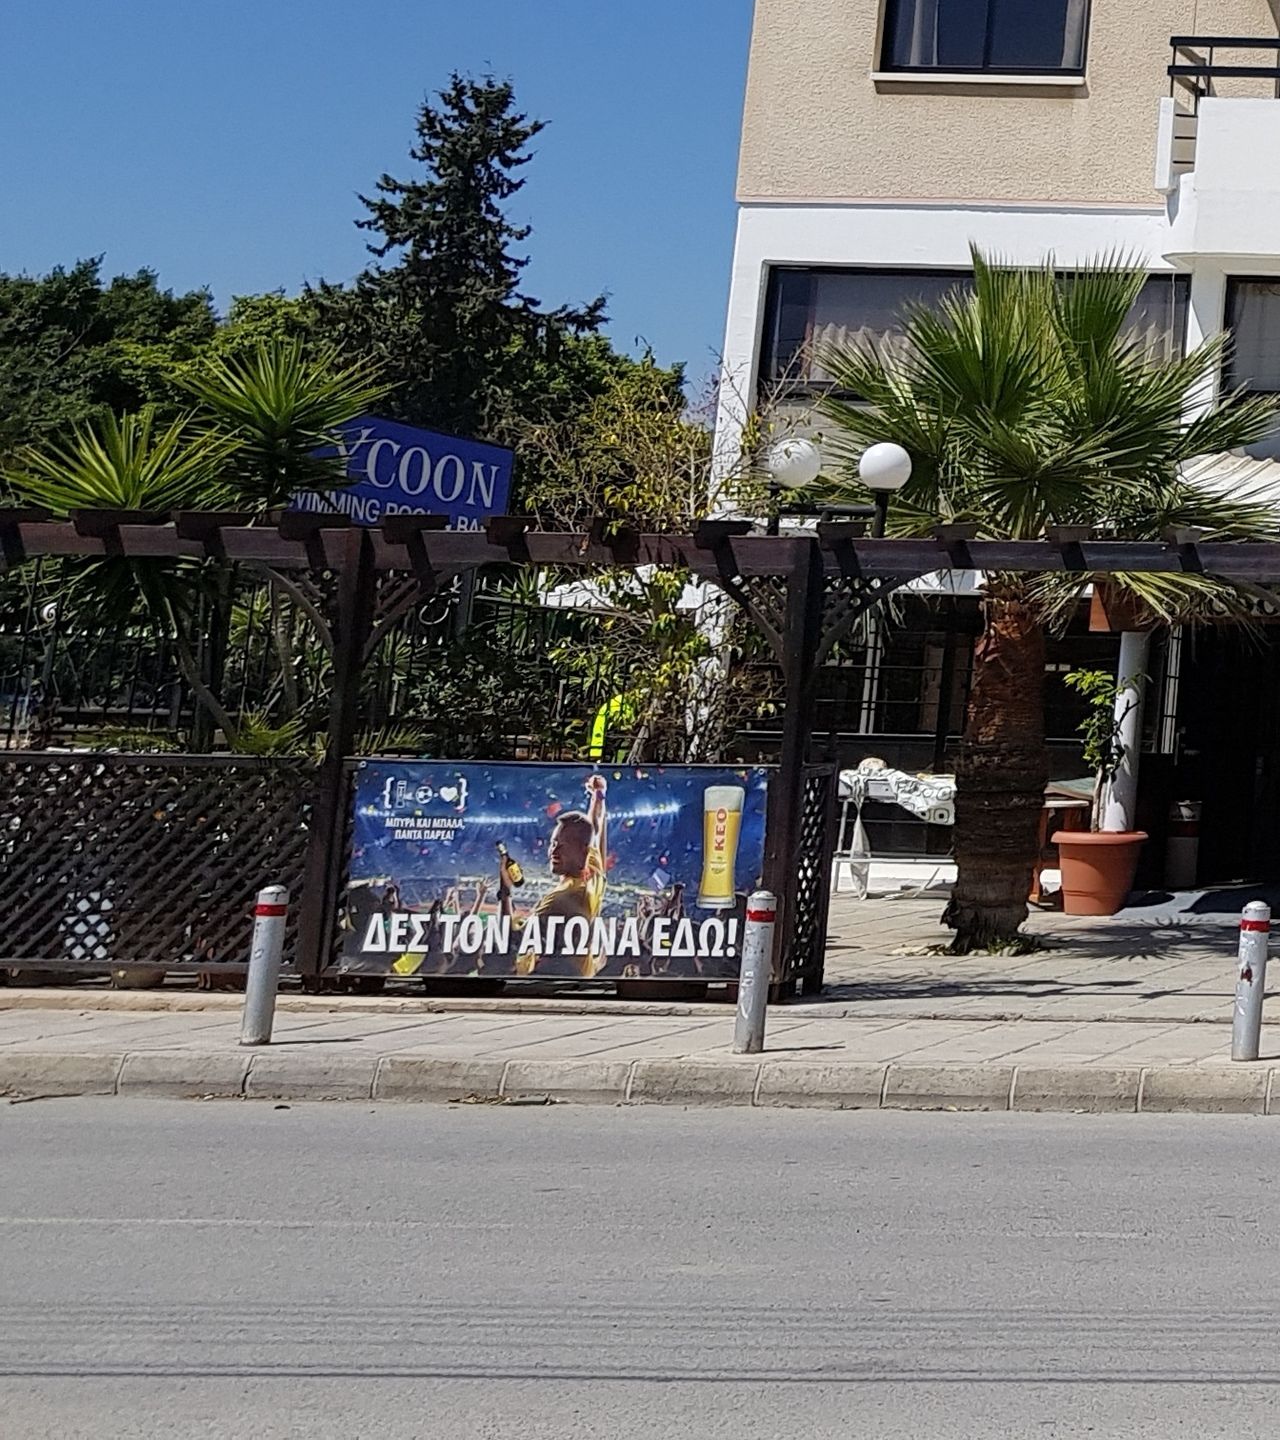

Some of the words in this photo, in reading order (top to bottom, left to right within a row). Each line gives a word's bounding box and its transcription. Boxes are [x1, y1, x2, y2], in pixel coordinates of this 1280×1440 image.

[330, 426, 500, 509] YCOON
[714, 807, 728, 852] KEO
[361, 912, 431, 954] ΔΕΣ
[436, 913, 513, 956] ΤΟΝ
[518, 915, 642, 957] ΑΓΩΝΑ
[651, 916, 739, 958] ΕΔΩ!
